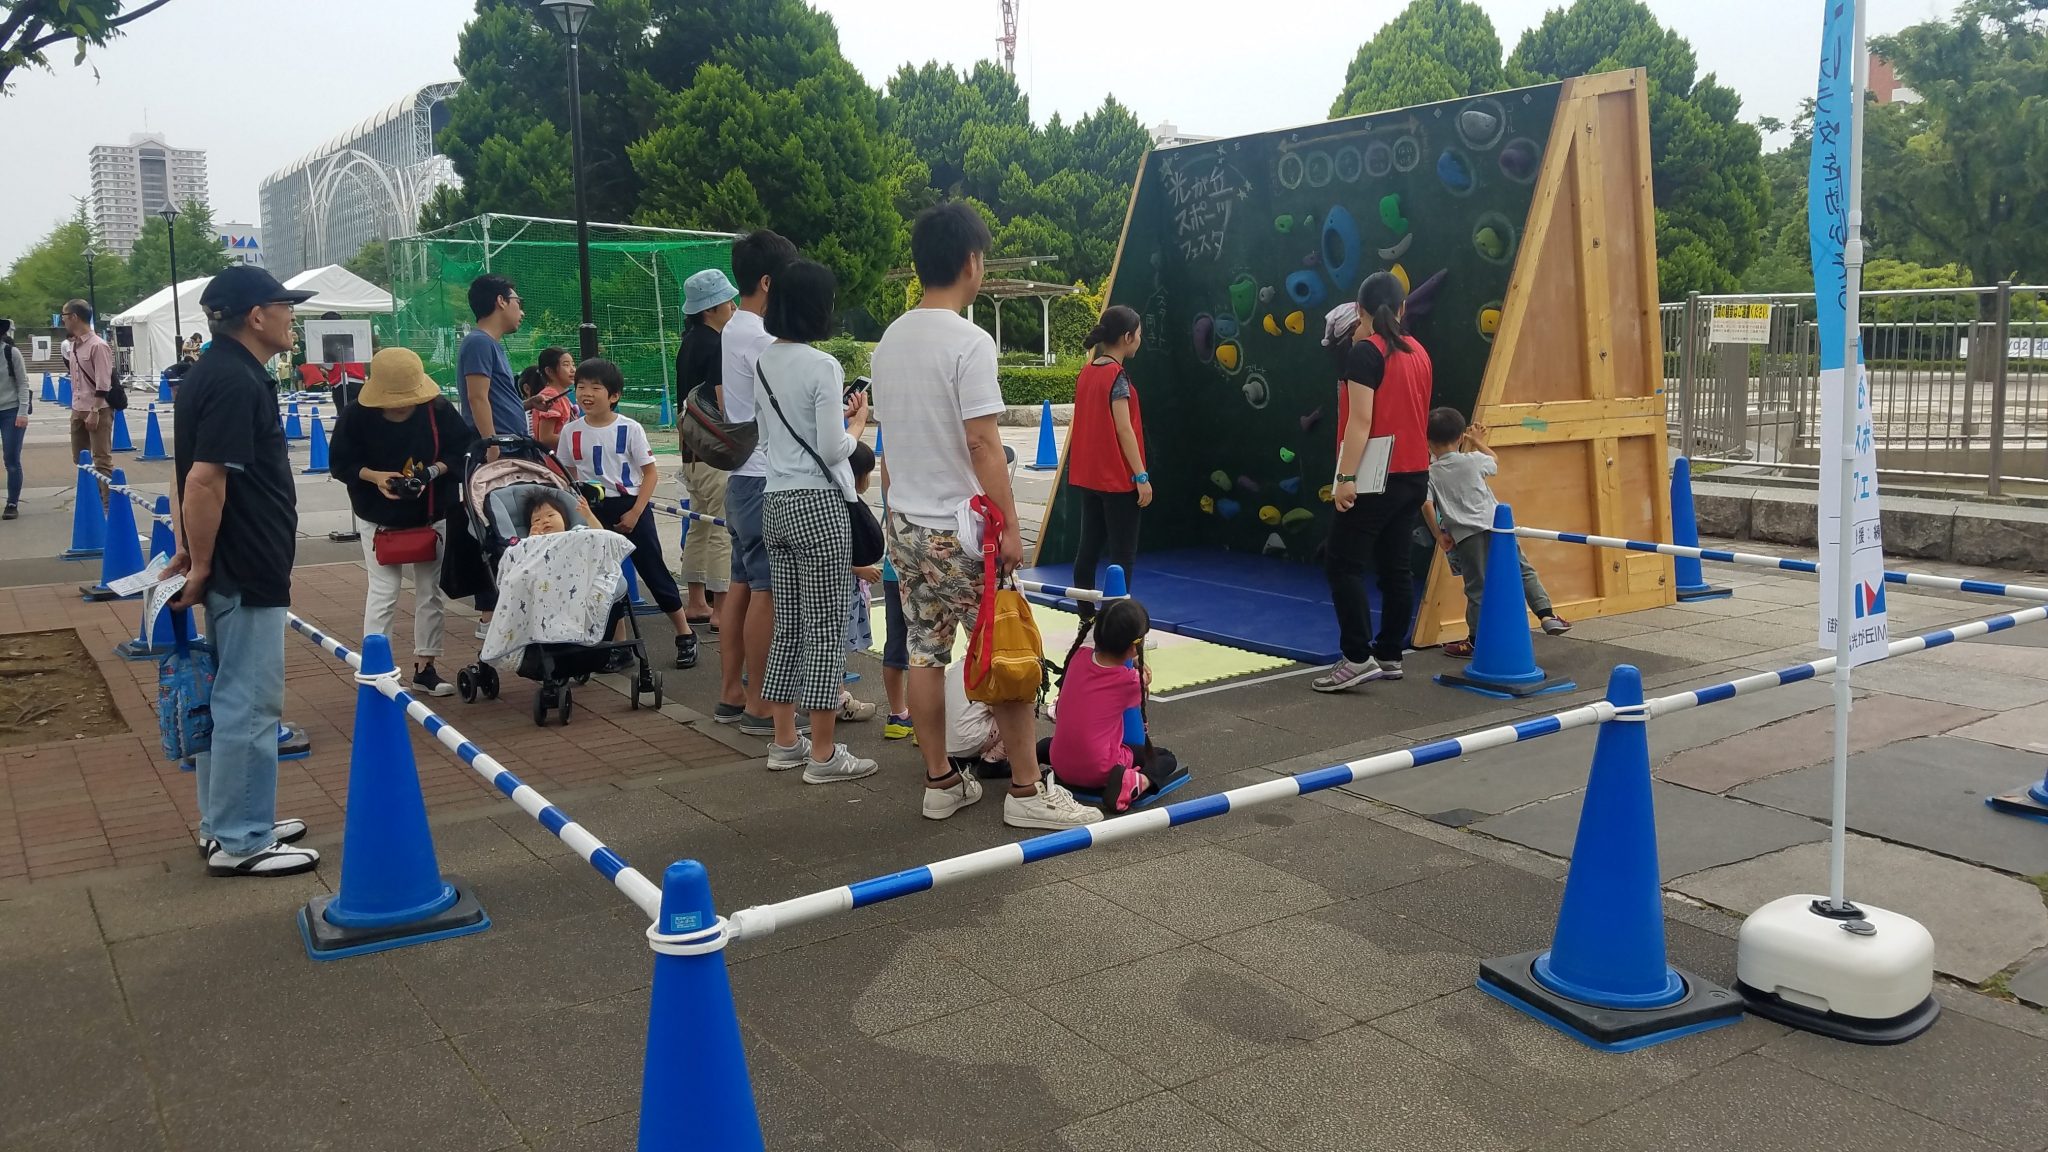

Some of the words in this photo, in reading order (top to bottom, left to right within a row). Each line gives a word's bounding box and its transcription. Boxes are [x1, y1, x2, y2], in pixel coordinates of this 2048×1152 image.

[1168, 166, 1233, 207] 光が丘
[1175, 200, 1232, 236] スポーツ
[221, 235, 259, 248] IMA
[1180, 230, 1225, 261] フェスタ
